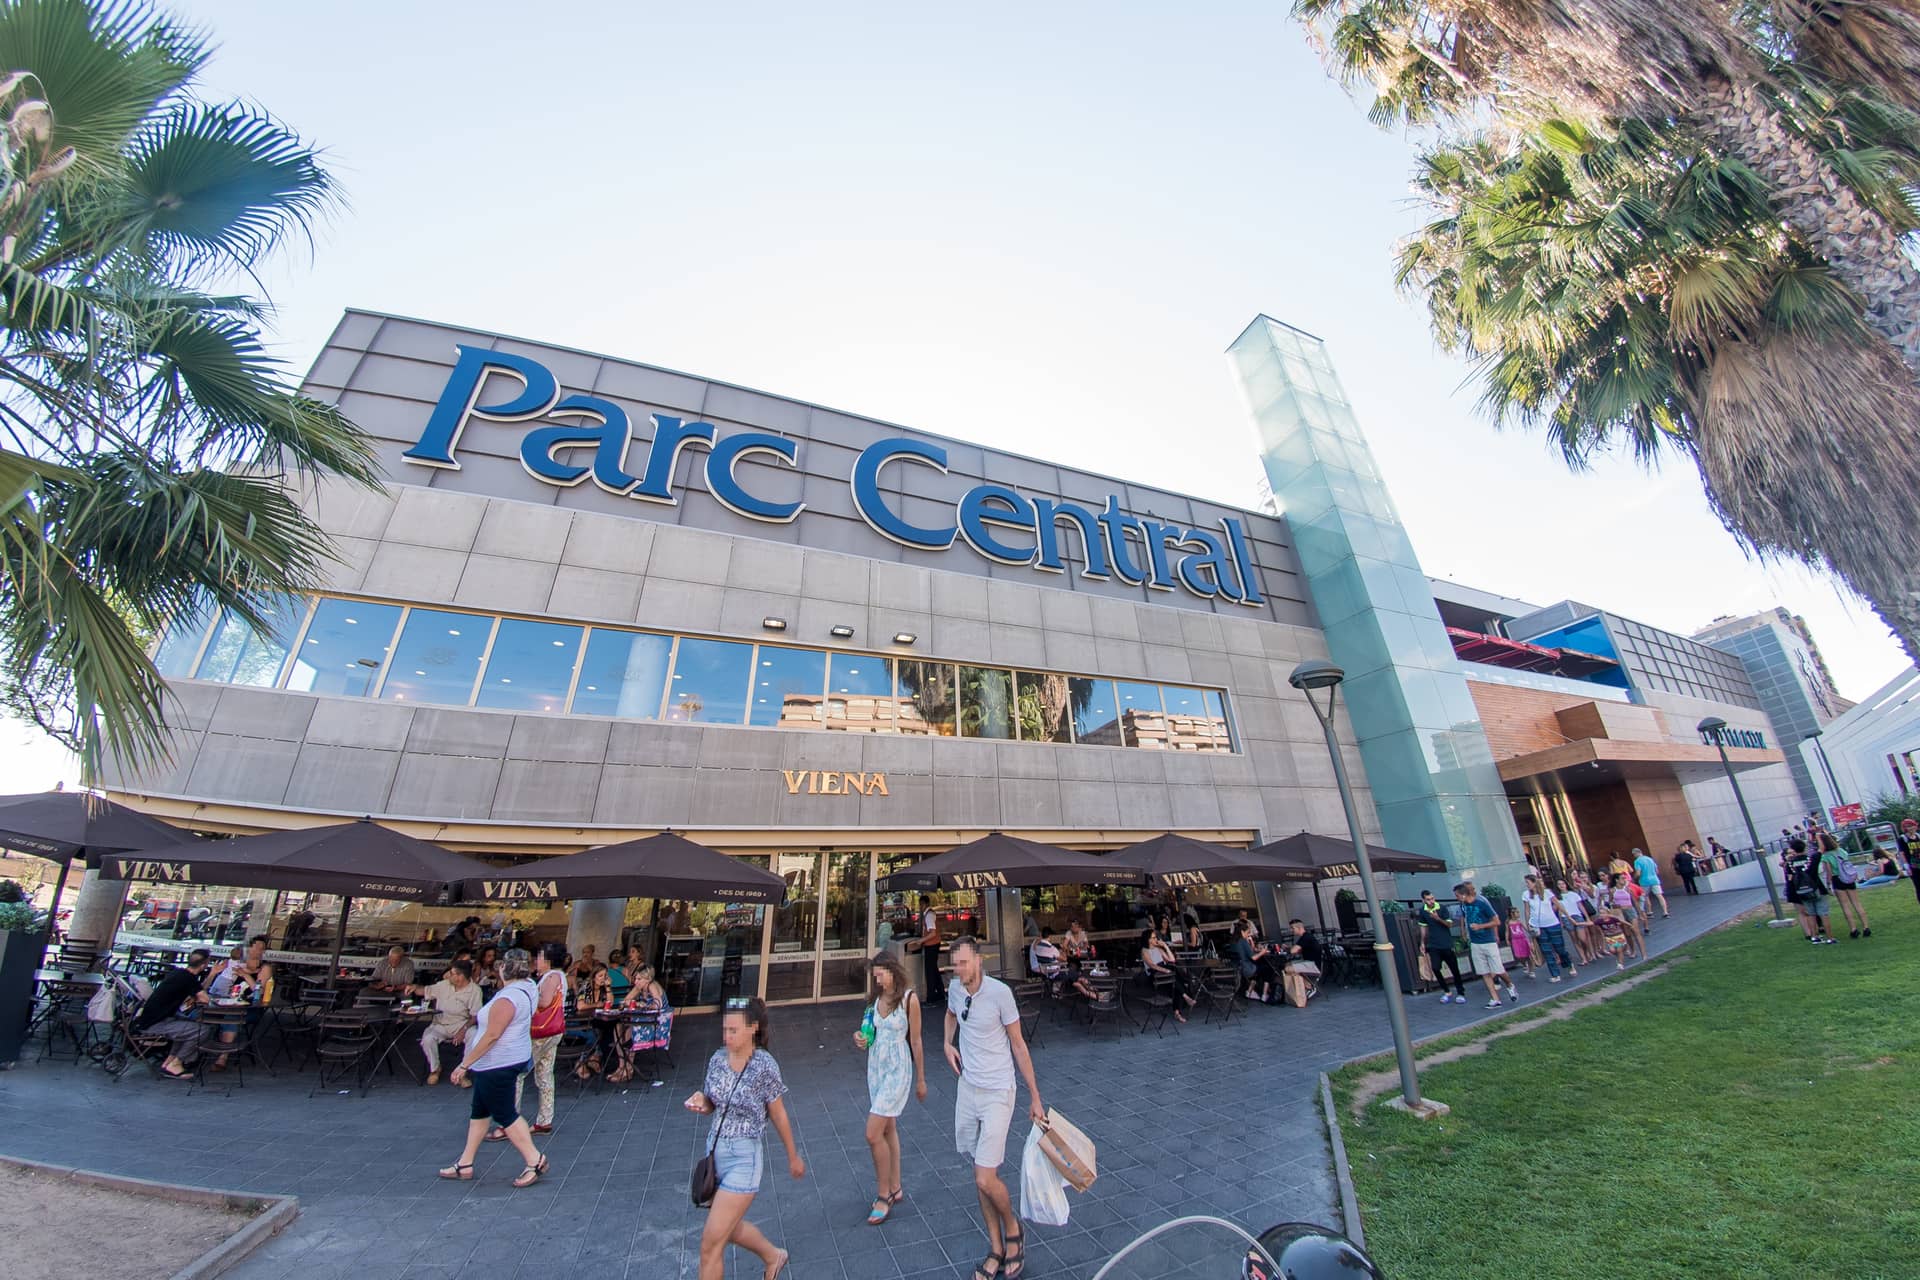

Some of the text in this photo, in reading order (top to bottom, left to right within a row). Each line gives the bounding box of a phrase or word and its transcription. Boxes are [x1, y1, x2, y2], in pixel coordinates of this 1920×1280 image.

[402, 344, 1265, 608] Parc Central
[783, 770, 889, 797] VIENA
[117, 860, 192, 881] VIENA
[1162, 871, 1209, 888] VIENA
[1323, 863, 1360, 878] VIENA
[482, 880, 559, 898] VIENA
[953, 871, 1008, 889] VIENA
[398, 886, 417, 894] 1969
